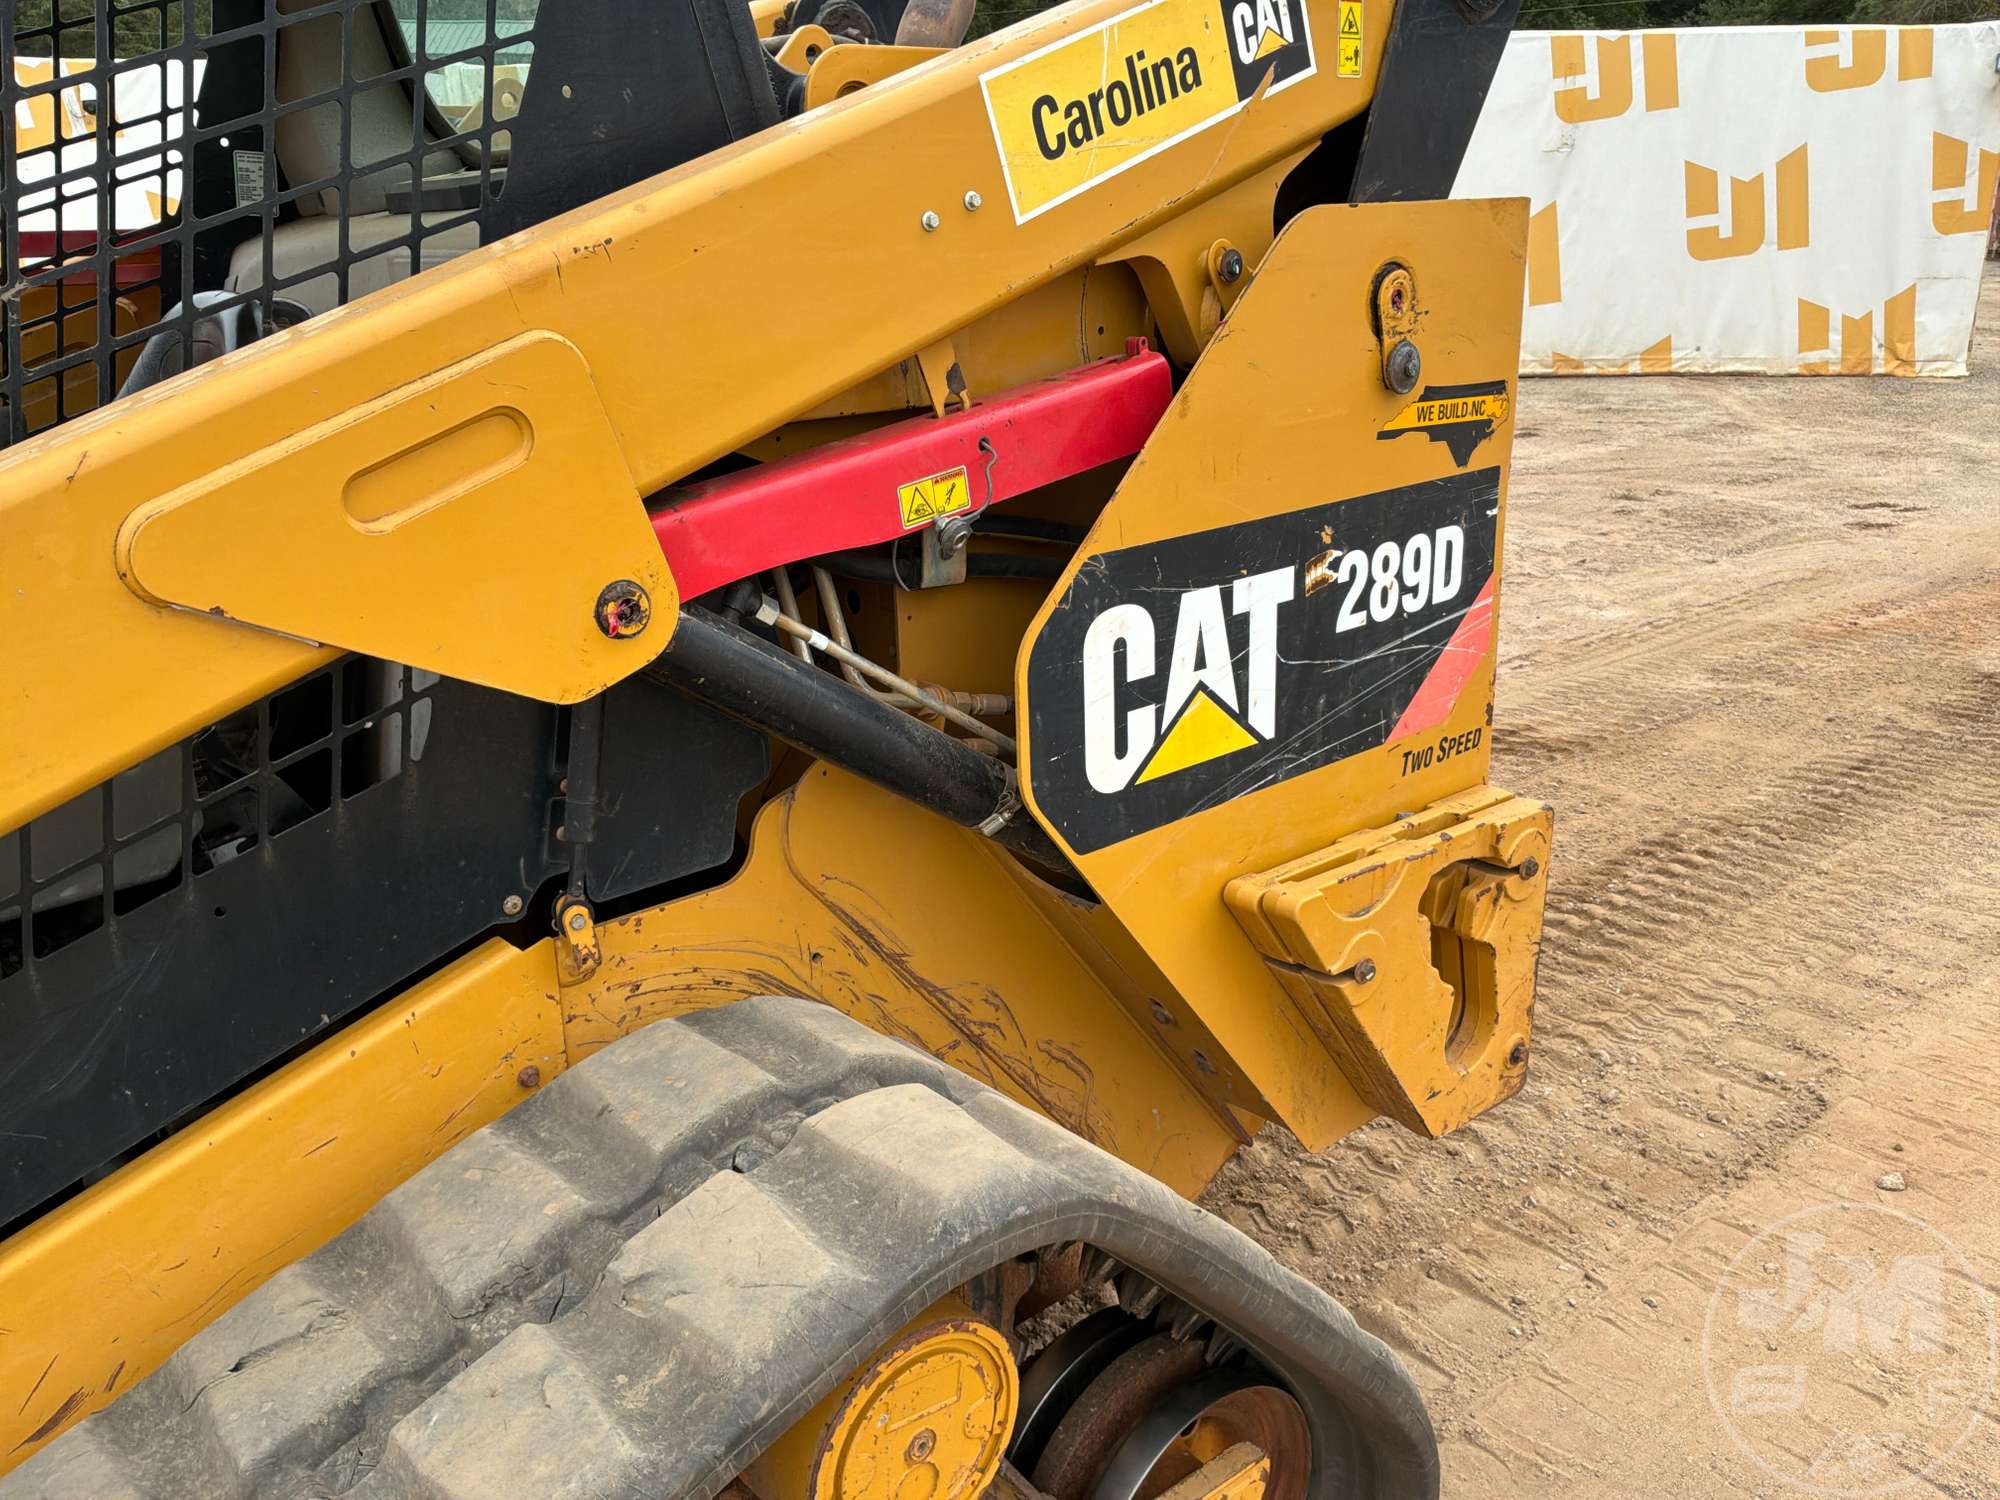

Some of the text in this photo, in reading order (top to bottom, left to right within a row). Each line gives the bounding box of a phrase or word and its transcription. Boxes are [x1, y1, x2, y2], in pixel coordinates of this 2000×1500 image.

[1232, 0, 1294, 65] CAT
[1031, 46, 1202, 161] Carolina
[1417, 399, 1486, 422] WE BUILD NC
[1083, 525, 1464, 794] CAT 289D
